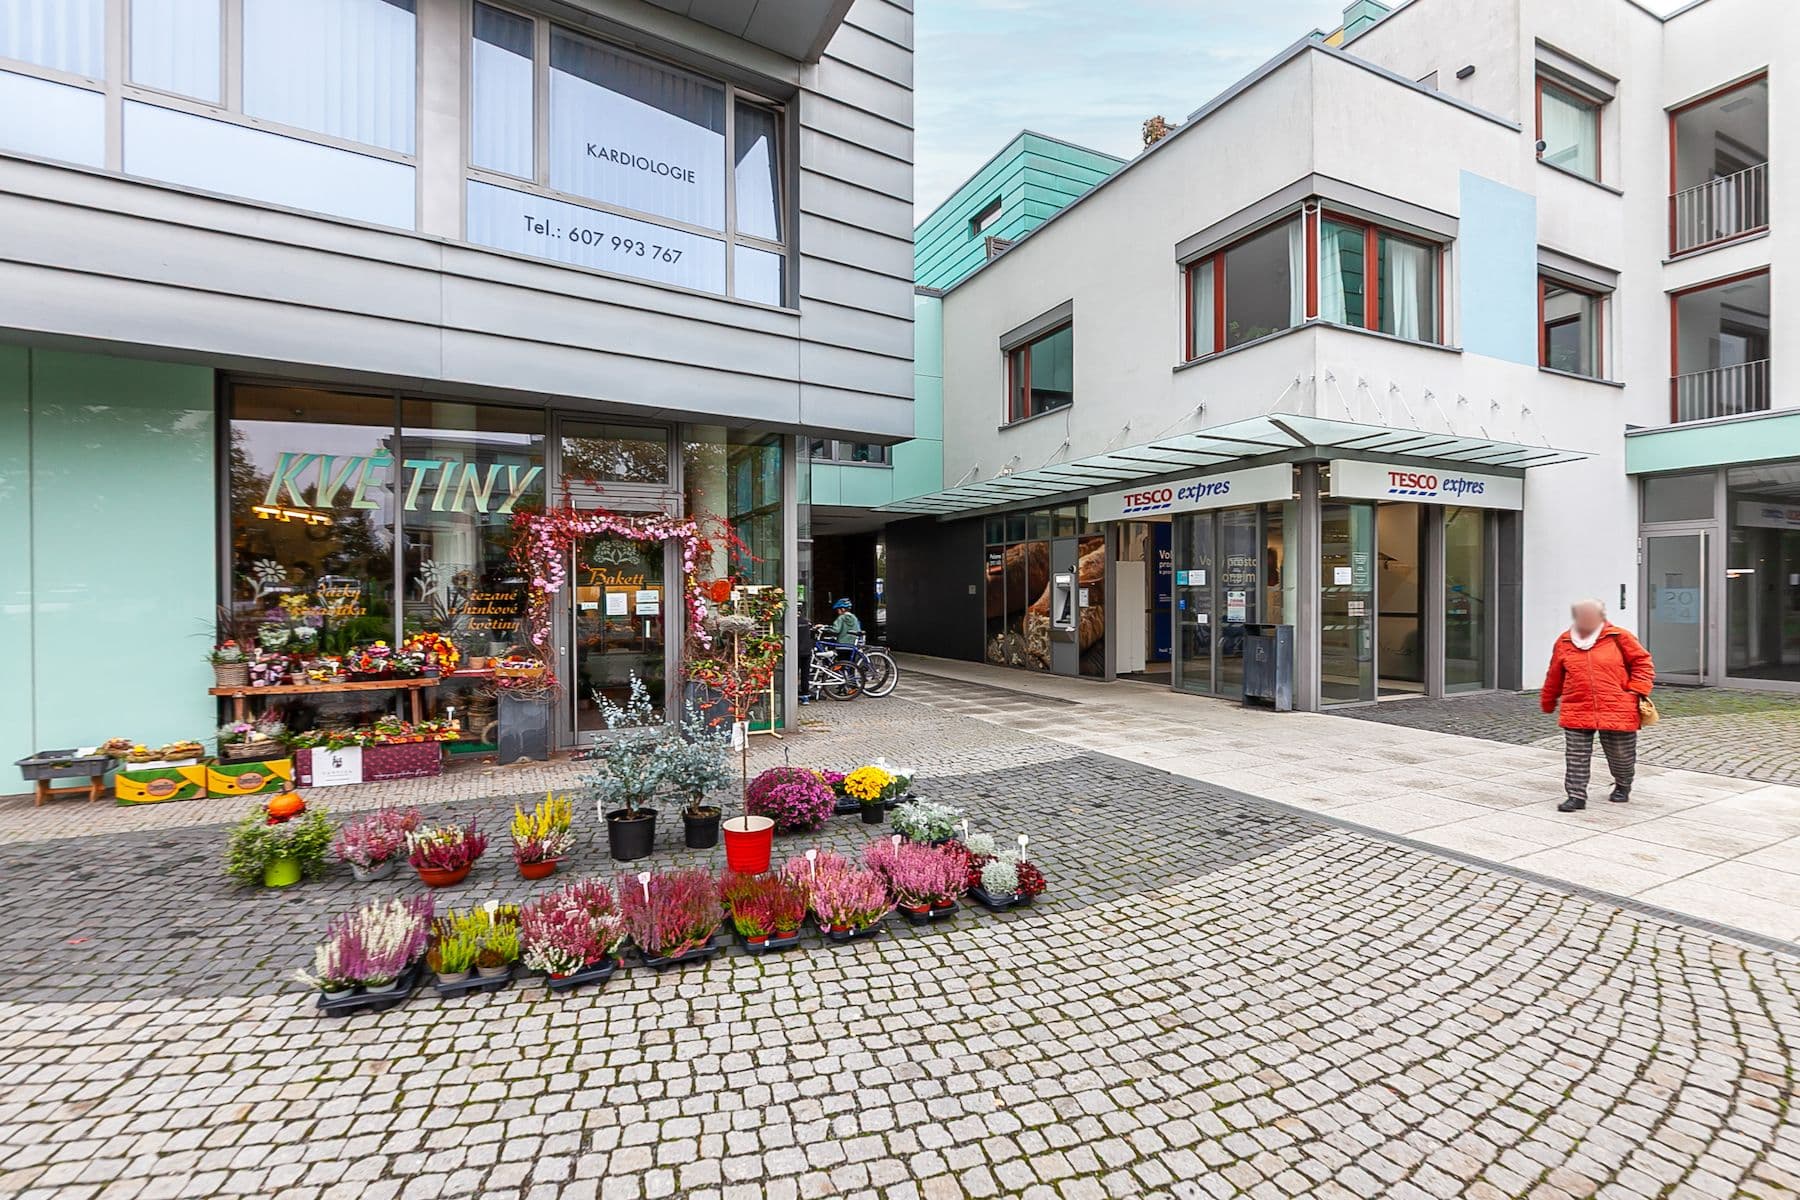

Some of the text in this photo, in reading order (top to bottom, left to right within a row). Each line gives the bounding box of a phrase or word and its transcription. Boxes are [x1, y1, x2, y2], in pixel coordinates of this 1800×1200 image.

[587, 142, 696, 184] KARDIOLOGIE
[524, 214, 683, 264] Tel.: 607 993 767
[1124, 481, 1230, 507] TESCO expres
[1388, 472, 1485, 497] TESCO expres
[467, 617, 520, 632] květiny
